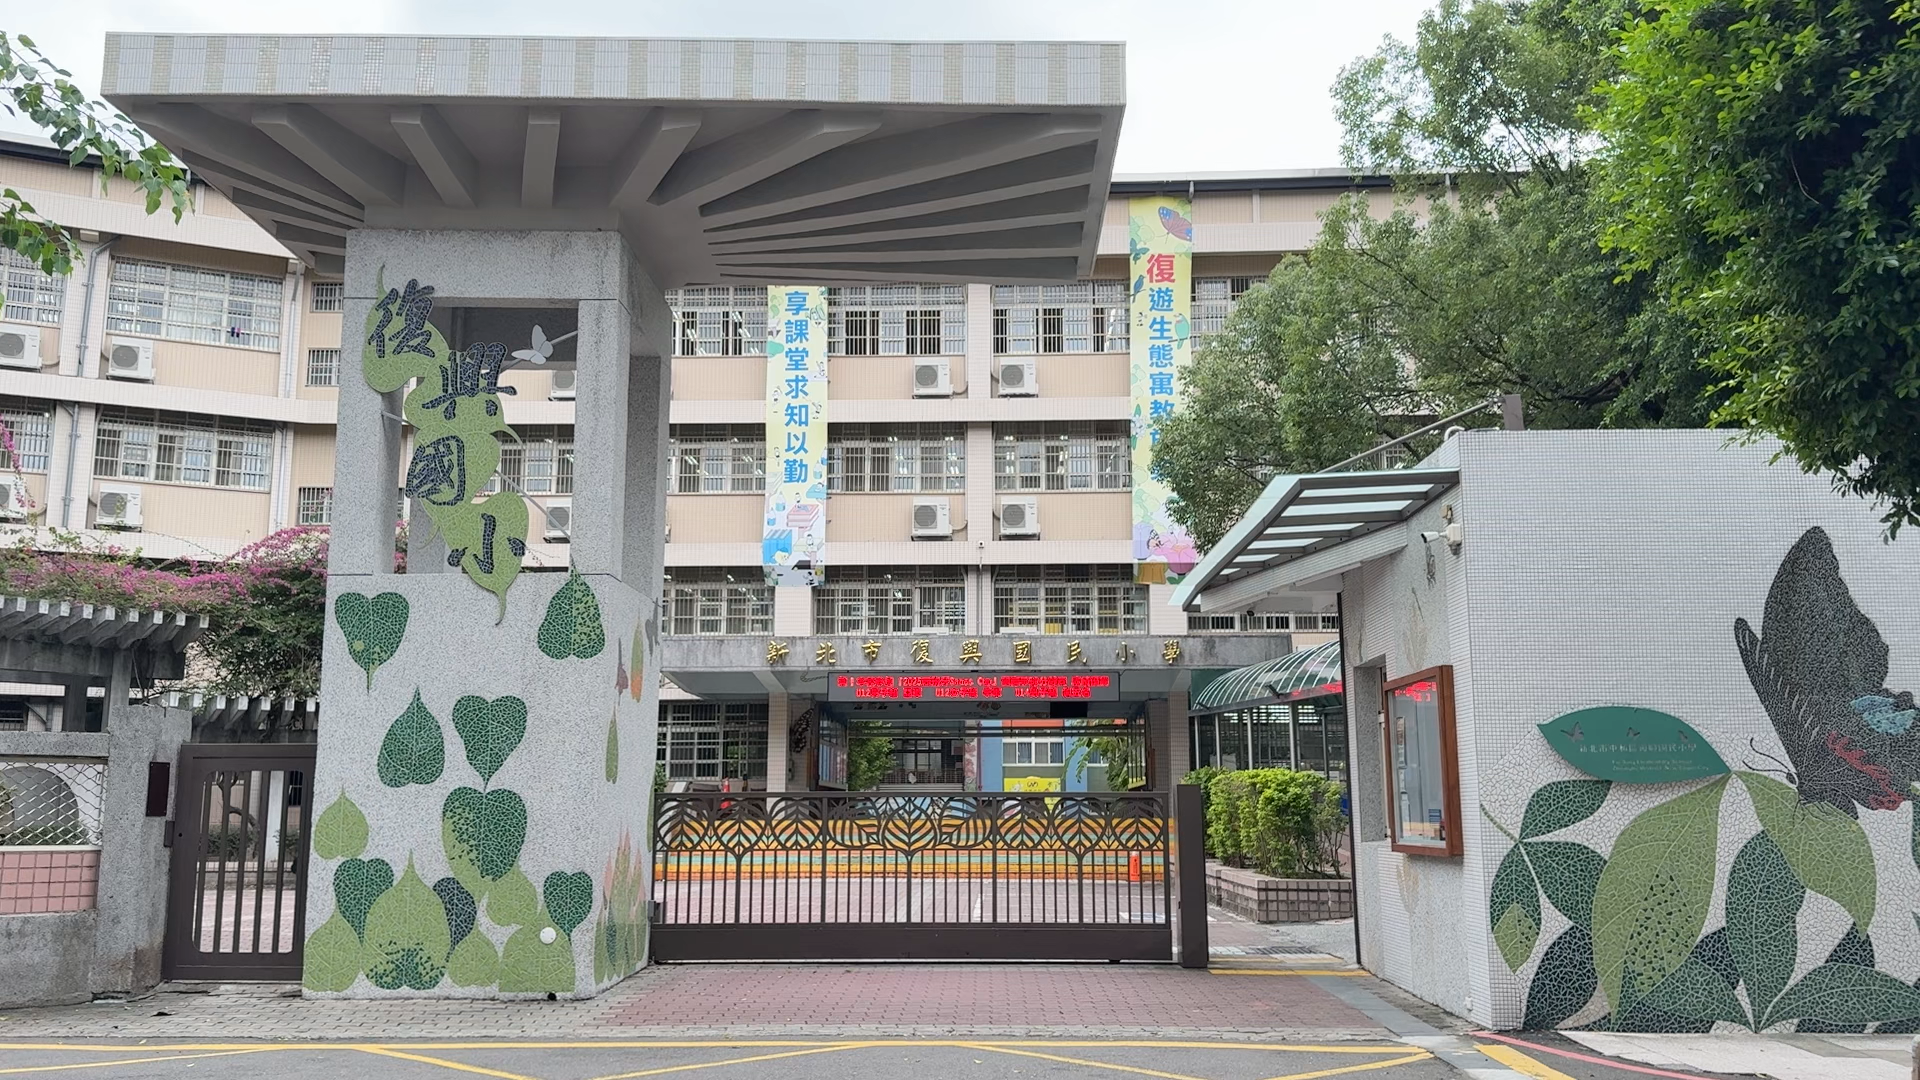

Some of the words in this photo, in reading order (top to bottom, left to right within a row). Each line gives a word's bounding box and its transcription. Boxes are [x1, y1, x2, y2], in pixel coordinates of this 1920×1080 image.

[368, 278, 526, 574] 復興國小
[783, 290, 810, 485] 享課堂求知以勤
[1146, 253, 1176, 480] 復遊生態寓教
[765, 639, 1182, 666] 新北市復興國民小學
